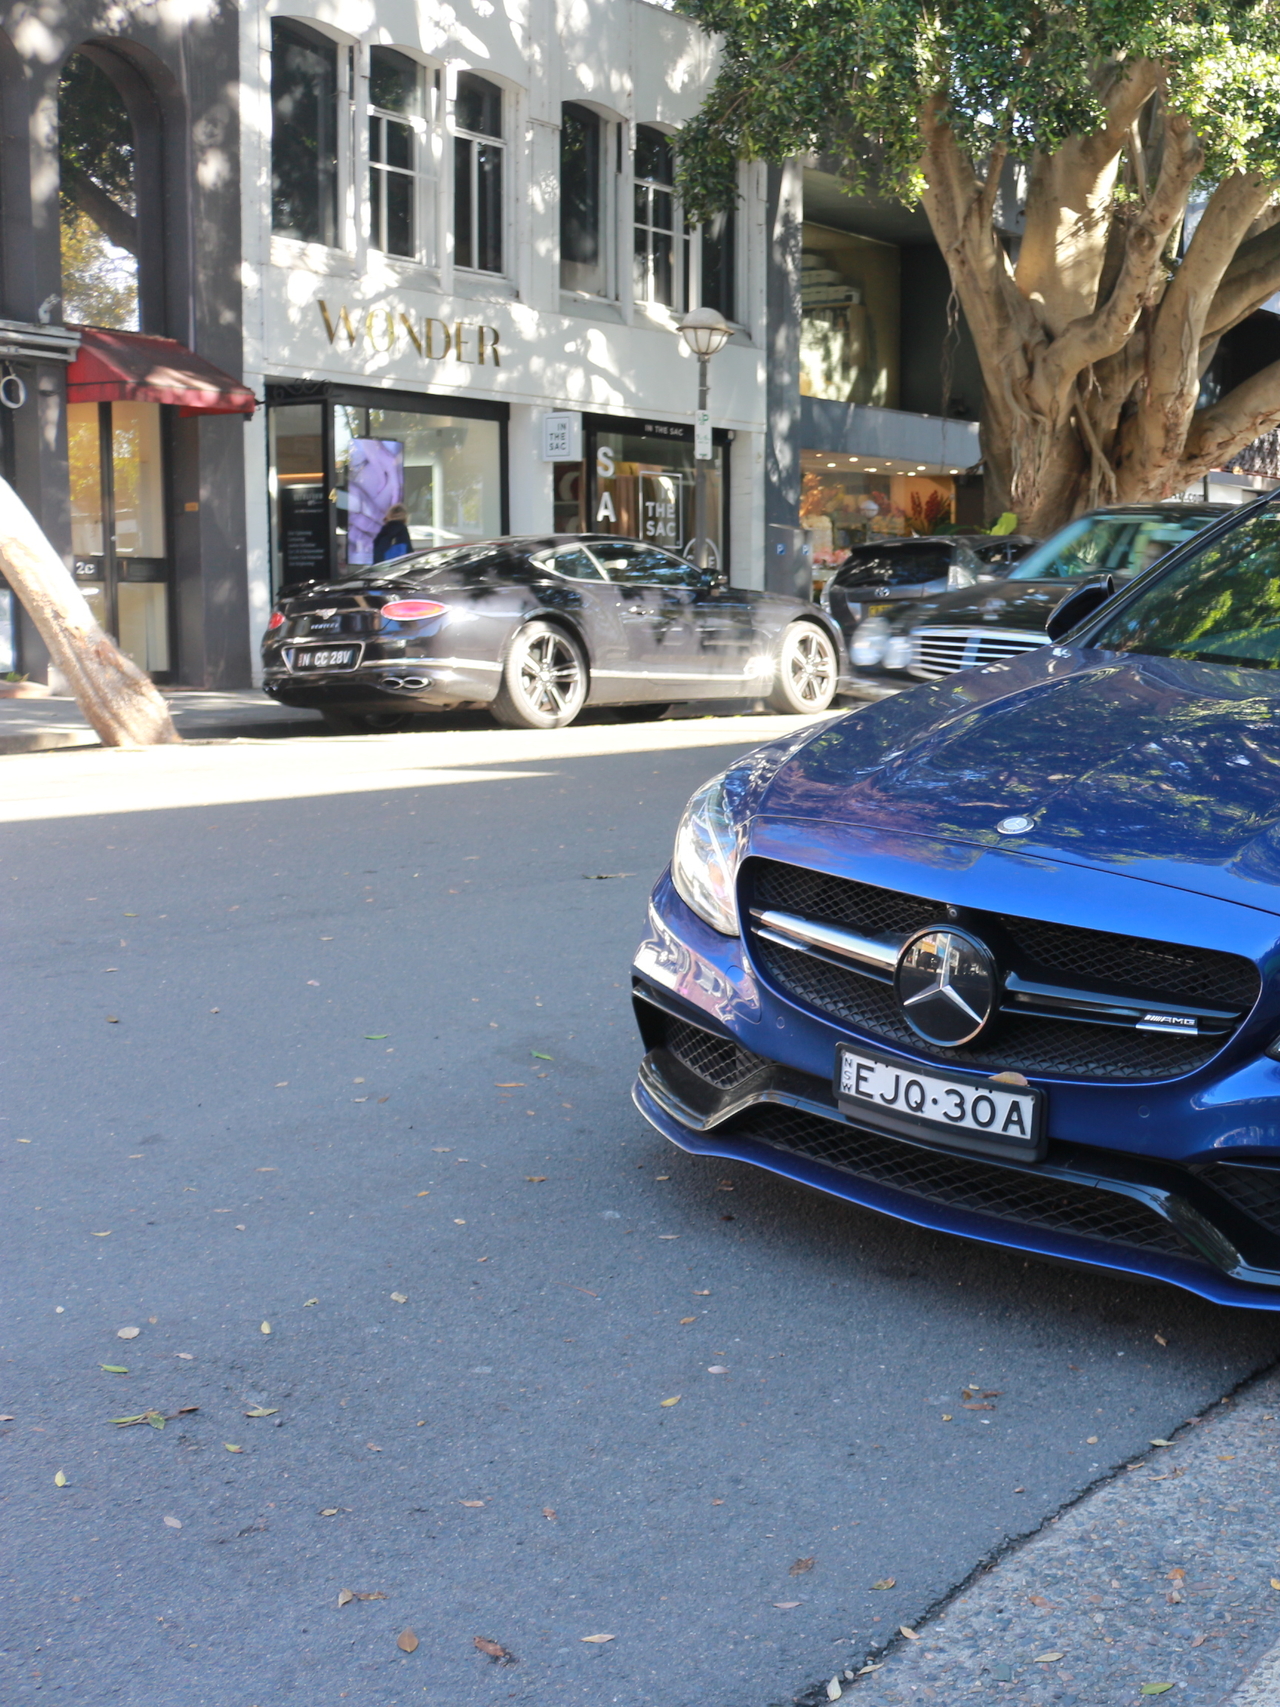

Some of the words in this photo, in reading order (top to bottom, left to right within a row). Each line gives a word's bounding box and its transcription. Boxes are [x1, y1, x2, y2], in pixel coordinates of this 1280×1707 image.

[317, 299, 501, 368] WONDER
[557, 423, 567, 431] IN
[644, 424, 653, 432] IN
[655, 425, 668, 435] THE
[669, 427, 684, 436] SAC
[549, 432, 566, 441] THE
[549, 442, 567, 451] SAC
[645, 501, 676, 518] THE
[646, 520, 677, 537] SAC
[314, 651, 329, 666] CC
[329, 649, 351, 665] 28V
[1160, 1016, 1196, 1026] AMG
[841, 1056, 854, 1093] NSW
